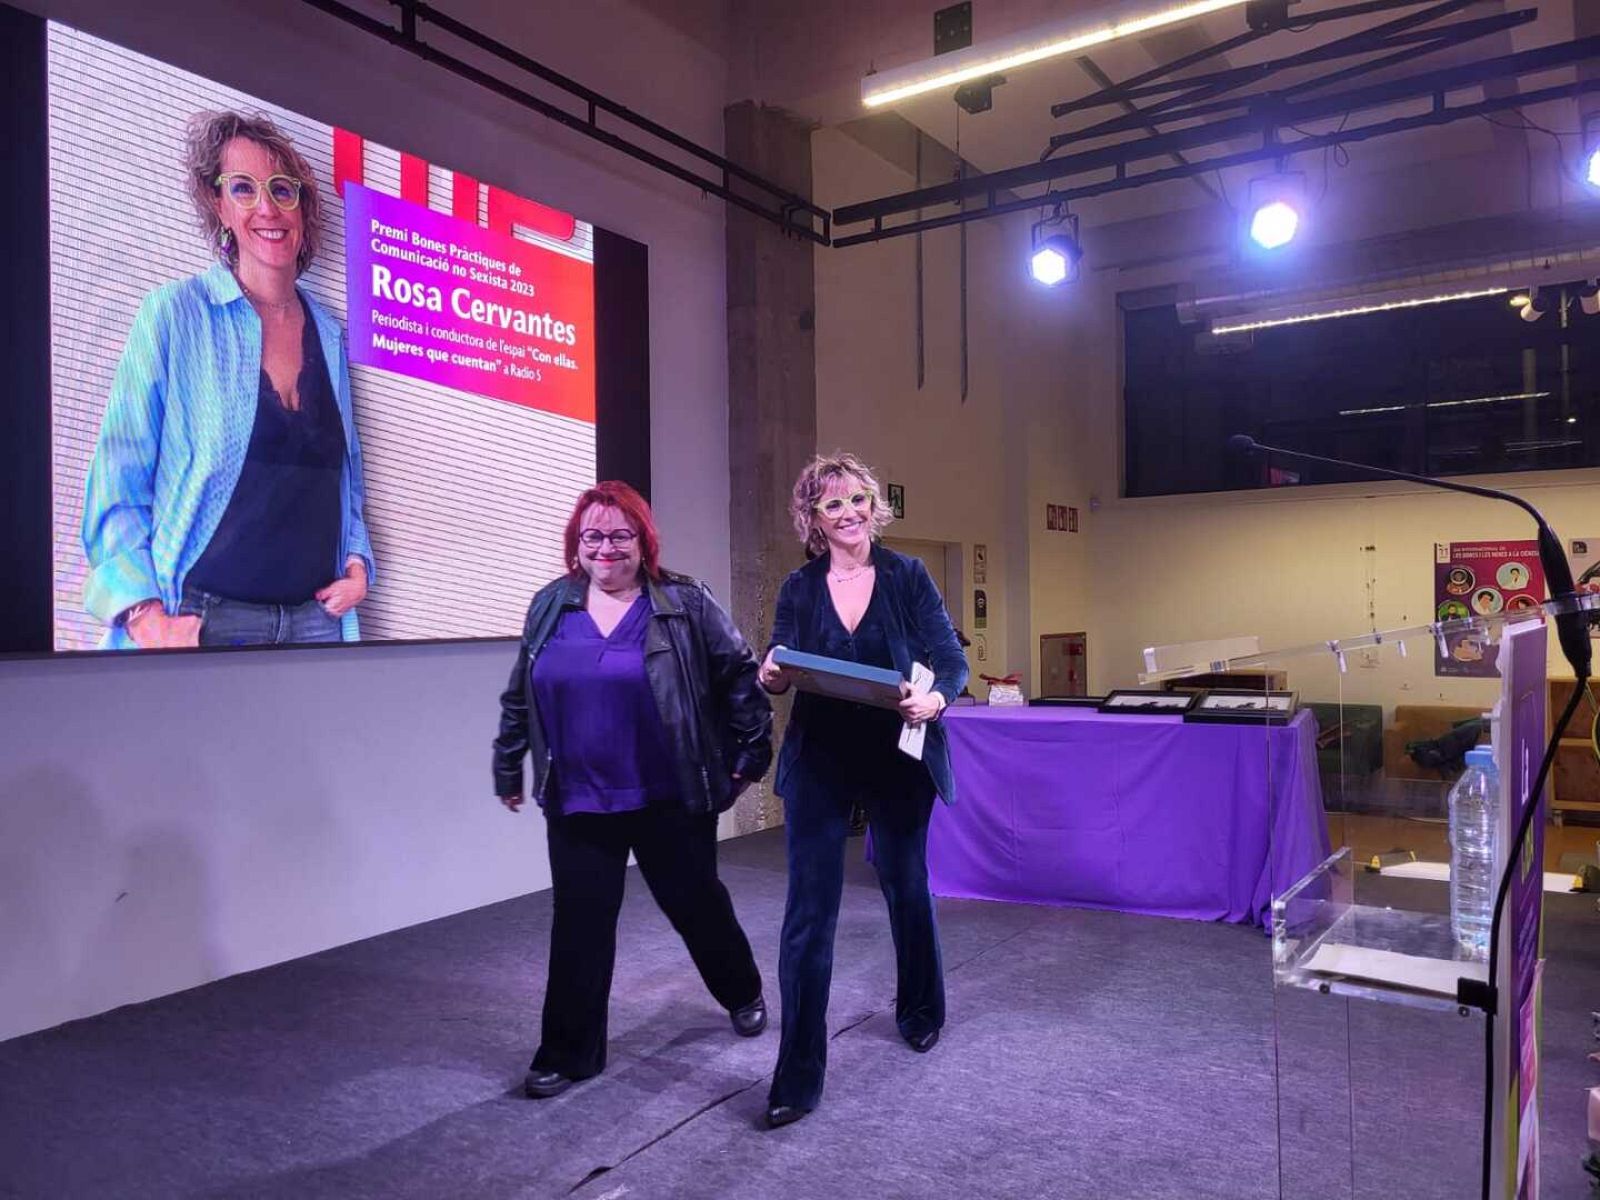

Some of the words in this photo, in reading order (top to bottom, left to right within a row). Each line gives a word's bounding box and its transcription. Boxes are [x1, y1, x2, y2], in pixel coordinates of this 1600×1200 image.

[371, 219, 408, 242] Premi
[412, 231, 447, 254] Bones
[449, 243, 506, 272] Pràctiques
[509, 263, 522, 276] de
[371, 238, 449, 272] Comunicació
[452, 264, 467, 277] no
[469, 267, 508, 290] Sexista
[510, 279, 535, 298] 2023
[372, 264, 442, 312] Rosa
[451, 287, 576, 346] Cervantes
[372, 309, 423, 335] Periodista
[425, 322, 429, 336] i
[431, 326, 484, 348] conductora
[486, 337, 498, 351] de
[499, 338, 526, 359] l'espai
[553, 352, 579, 370] ellas.
[373, 333, 424, 357] Mujeres
[427, 347, 449, 363] que
[451, 353, 502, 373] cuentan"
[503, 365, 509, 375] a
[510, 363, 535, 379] Radio
